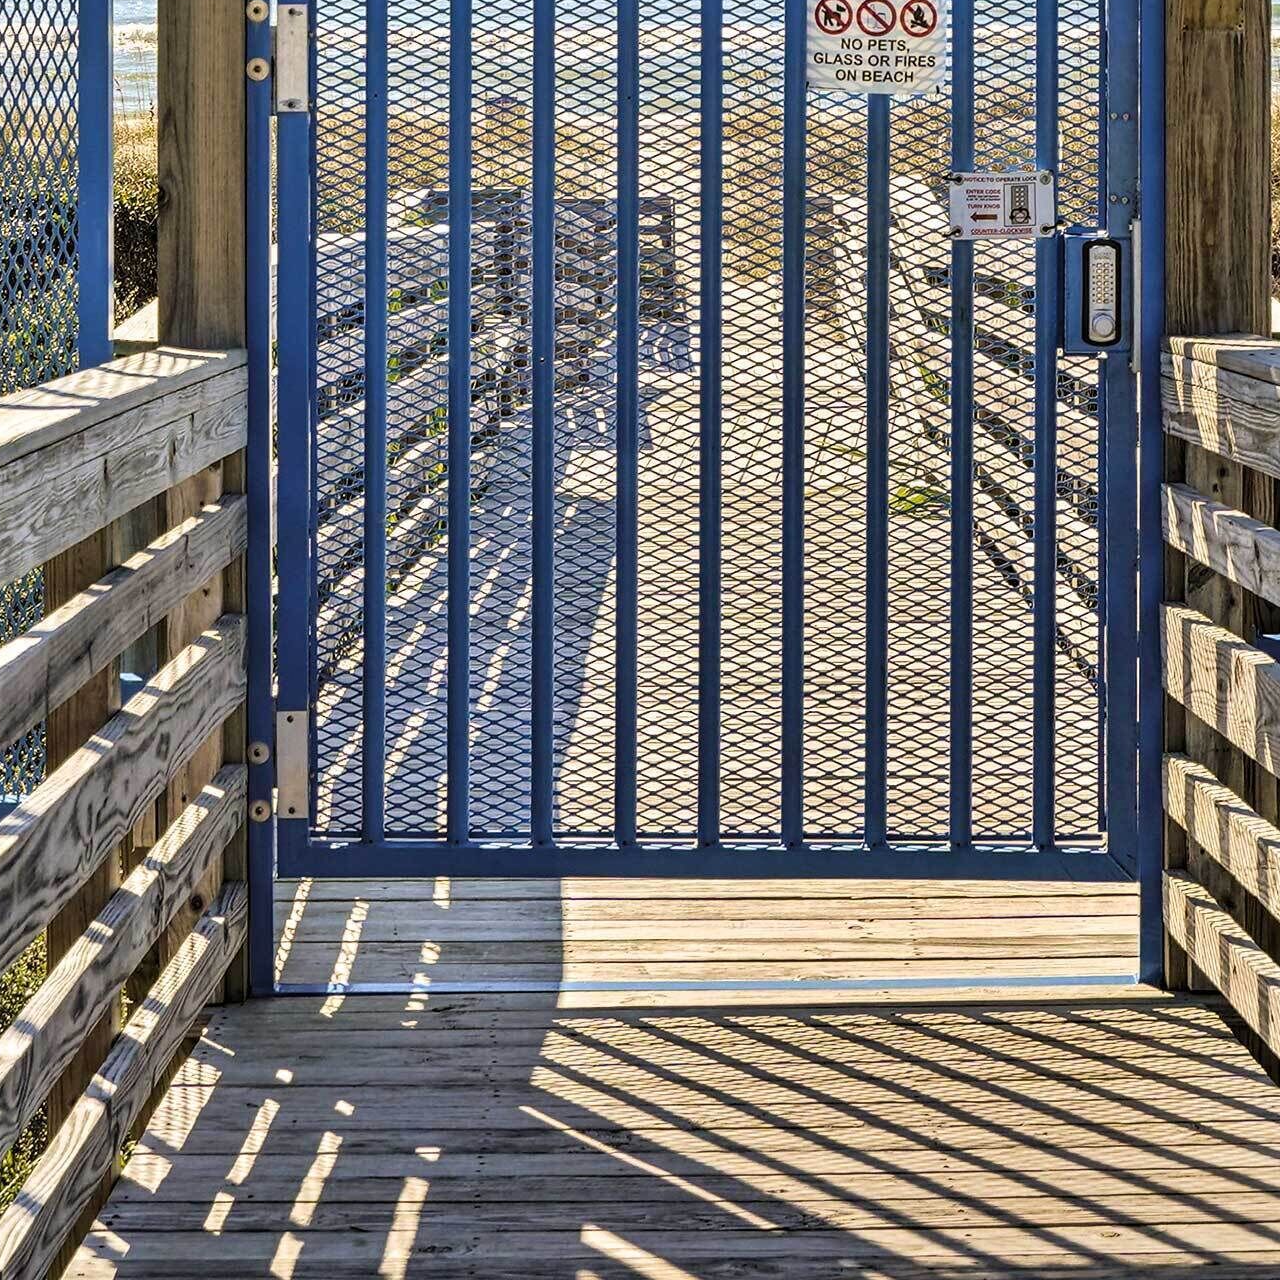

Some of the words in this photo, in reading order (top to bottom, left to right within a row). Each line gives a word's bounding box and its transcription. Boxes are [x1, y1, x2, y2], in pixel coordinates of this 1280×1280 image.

[841, 38, 863, 50] NO
[867, 39, 910, 53] PETS,
[813, 52, 863, 66] GLASS
[867, 54, 891, 67] OR
[894, 55, 936, 68] FIRES
[835, 69, 857, 81] ON
[862, 70, 914, 83] BEACH
